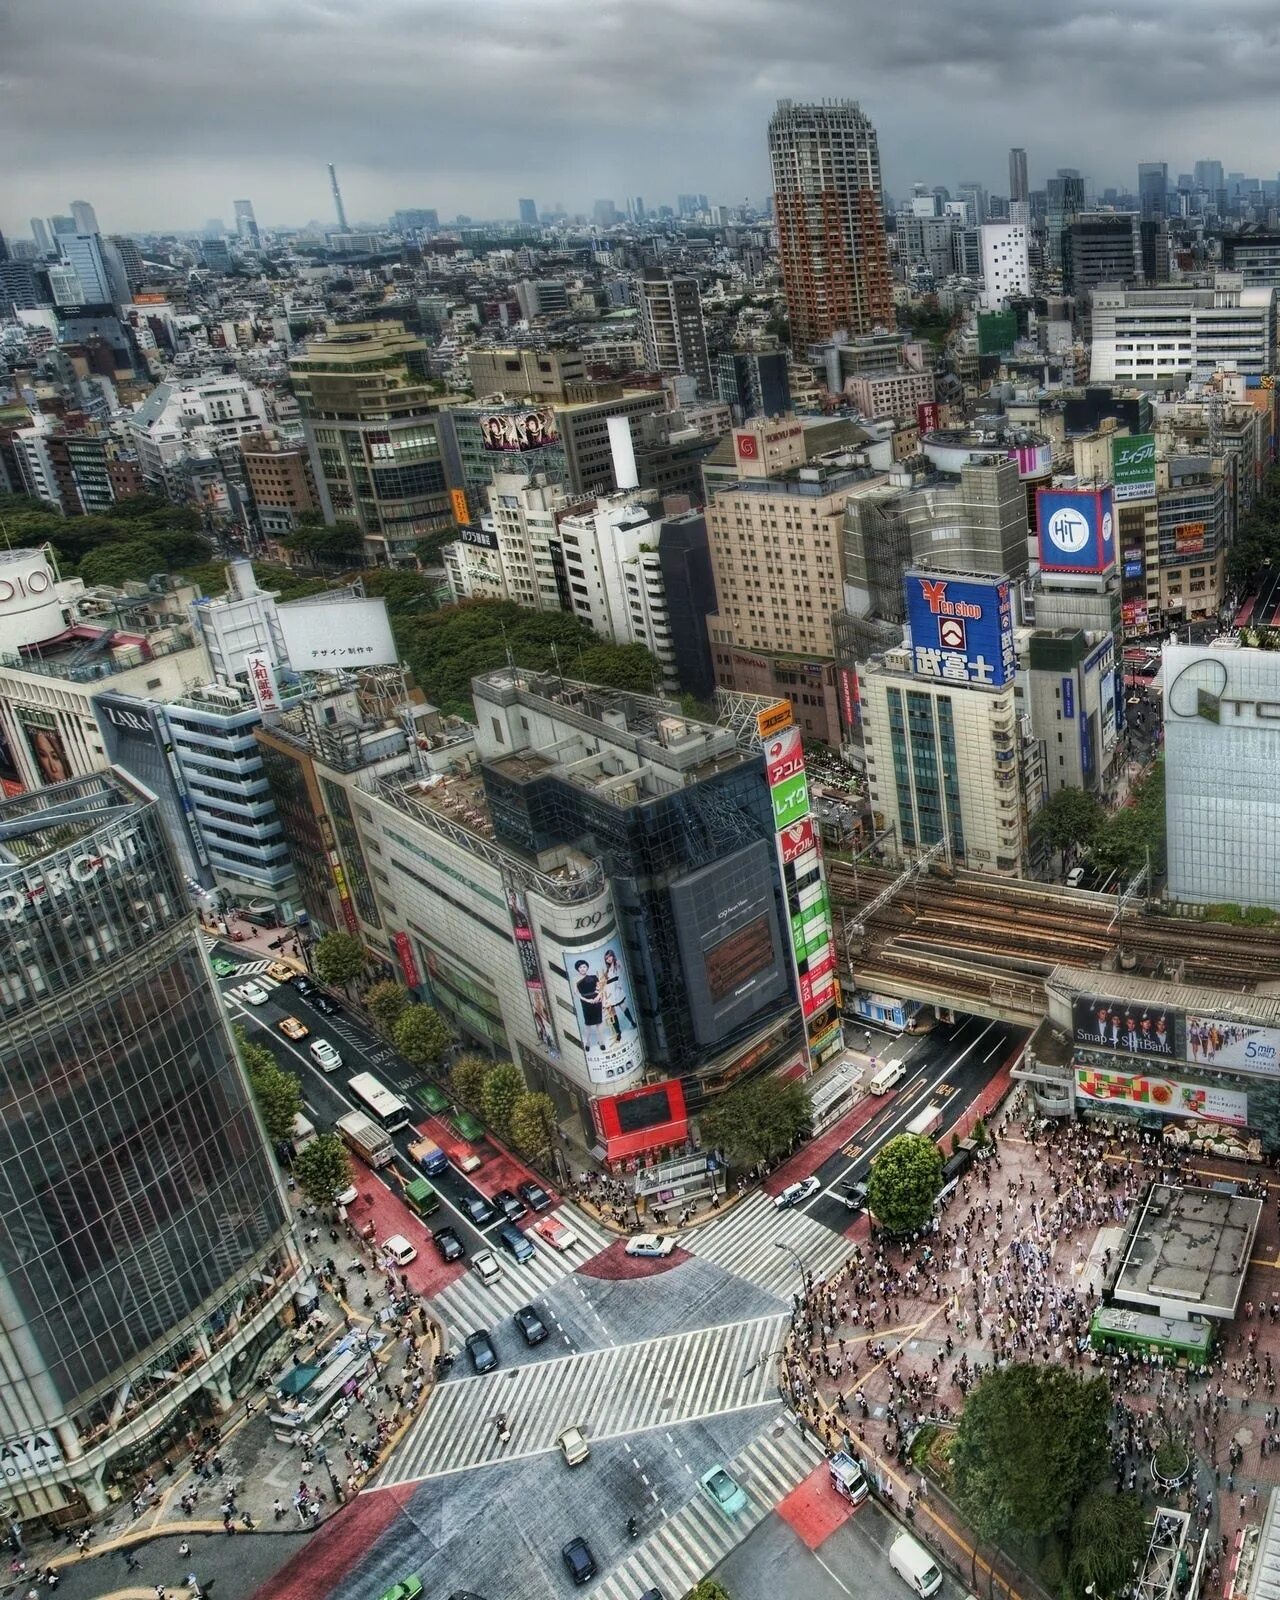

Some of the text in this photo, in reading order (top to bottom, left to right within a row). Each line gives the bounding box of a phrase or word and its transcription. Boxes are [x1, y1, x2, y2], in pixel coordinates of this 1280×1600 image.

[765, 429, 788, 443] TOKYU
[1115, 443, 1154, 466] エイブル
[955, 601, 981, 619] shop
[311, 646, 374, 658] デザイン制作中
[915, 646, 994, 683] 武富士
[250, 658, 275, 700] 大和証券
[102, 706, 153, 732] ZARA
[763, 712, 791, 731] プロミス
[772, 757, 804, 782] アコム
[776, 786, 806, 816] レイク
[784, 840, 813, 862] アイフル
[1077, 1028, 1173, 1055] Smap SoftBank
[1244, 1041, 1257, 1058] 5
